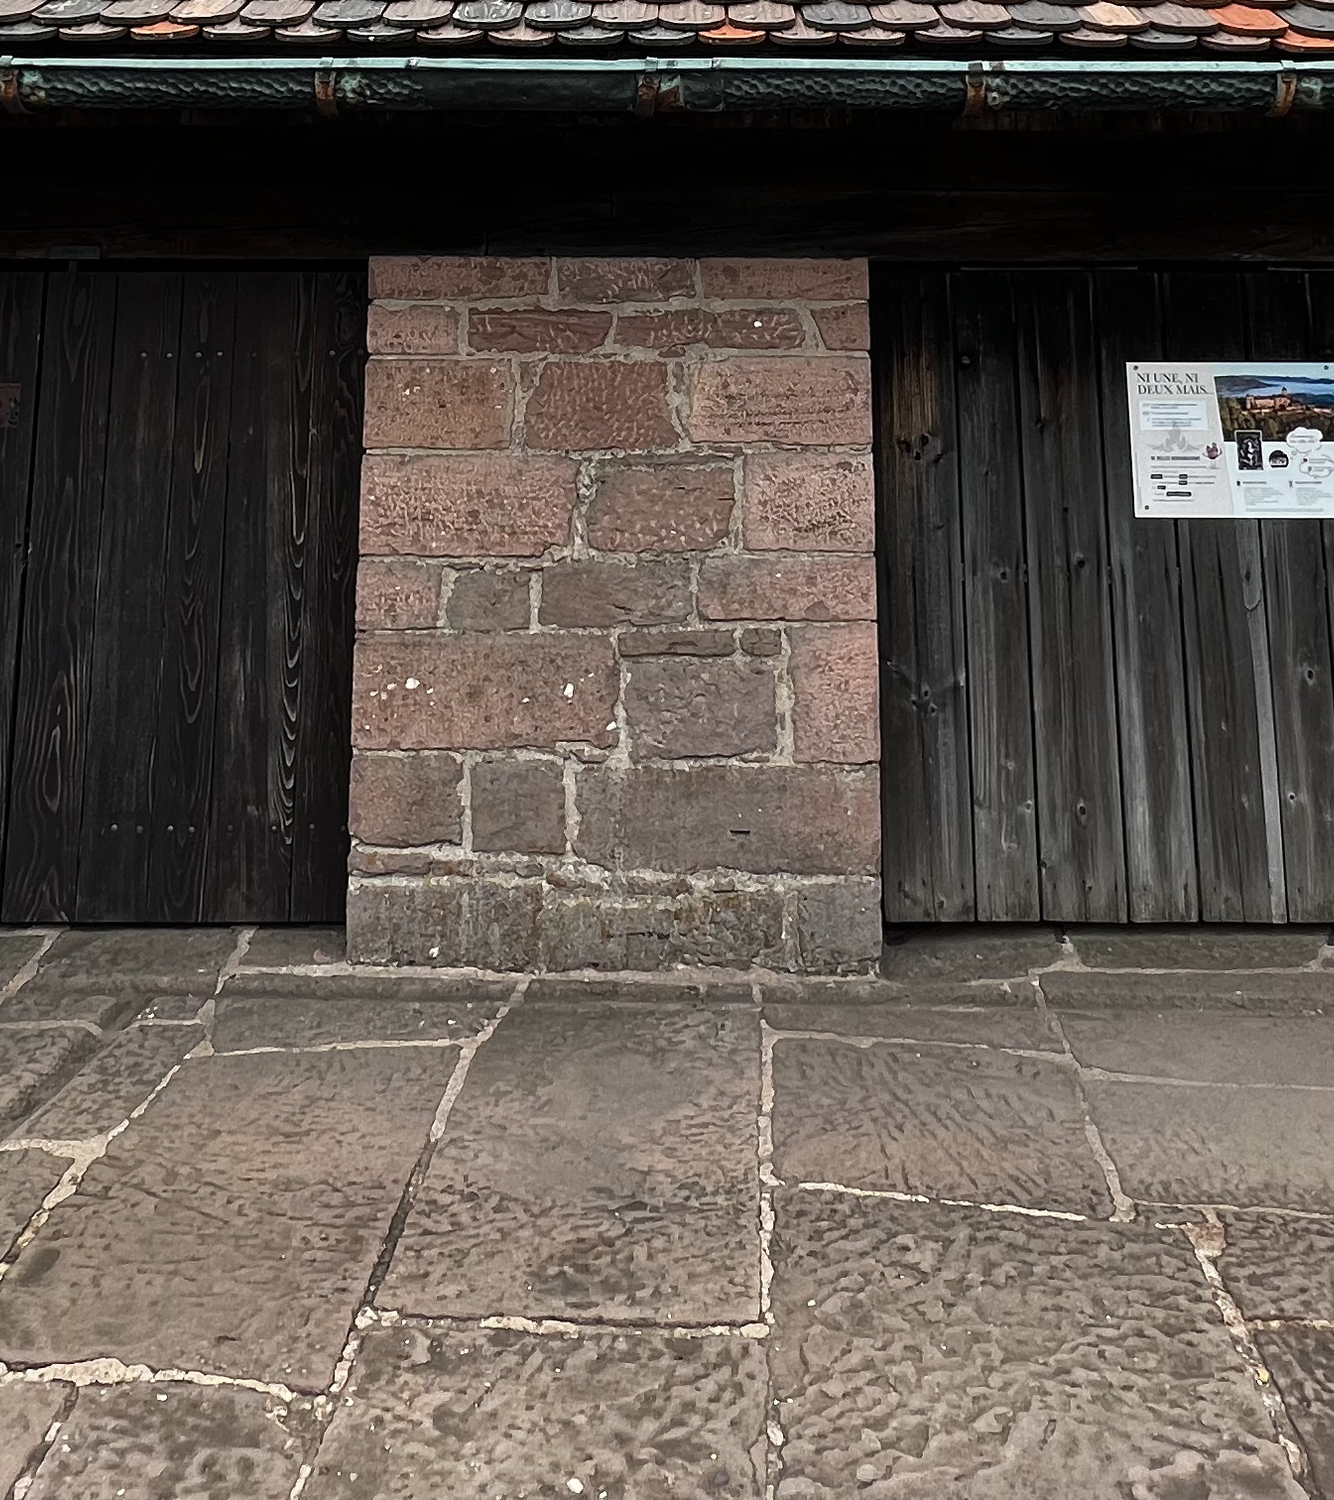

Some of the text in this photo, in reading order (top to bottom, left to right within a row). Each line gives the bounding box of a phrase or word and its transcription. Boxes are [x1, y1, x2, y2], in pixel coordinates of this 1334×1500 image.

[1137, 373, 1199, 384] NI UNE, NI
[1137, 384, 1173, 395] DEUX
